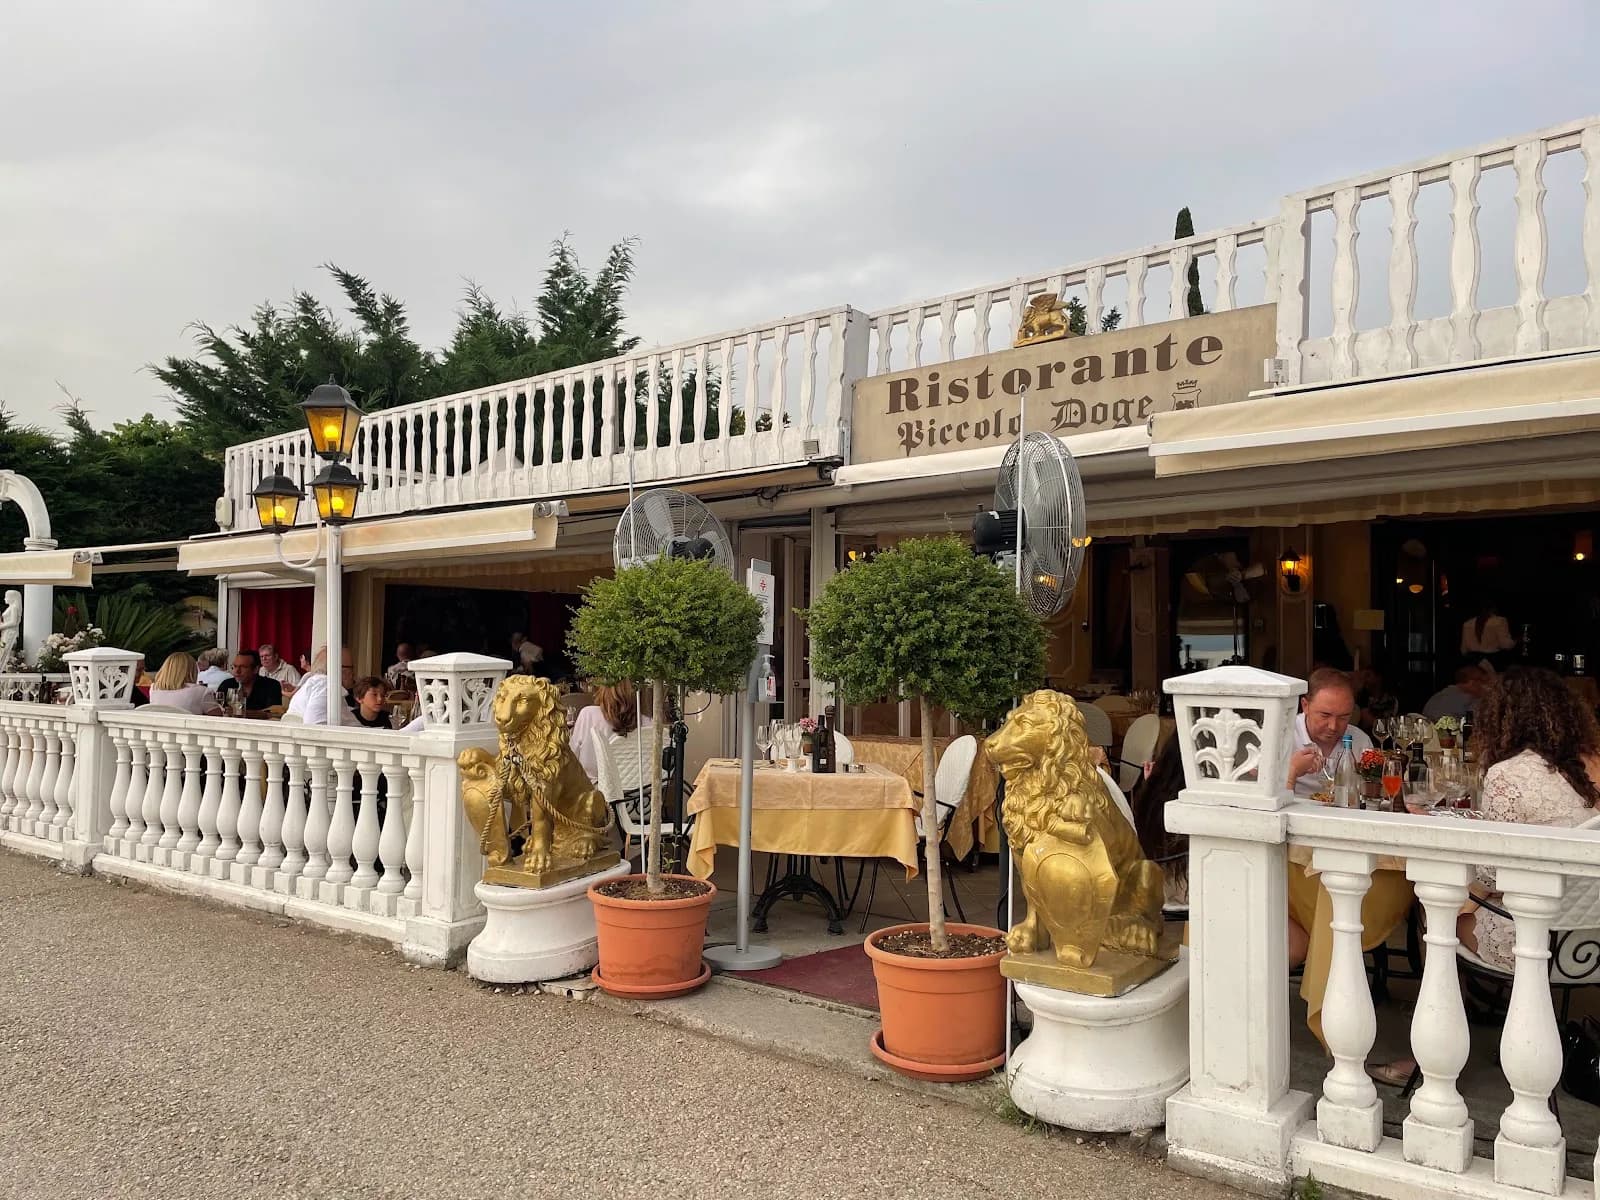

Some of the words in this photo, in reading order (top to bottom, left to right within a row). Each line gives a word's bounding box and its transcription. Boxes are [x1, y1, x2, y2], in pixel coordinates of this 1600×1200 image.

[886, 333, 1223, 414] Ristorante
[897, 408, 1023, 456] Piccolo
[1051, 395, 1153, 430] Doge
